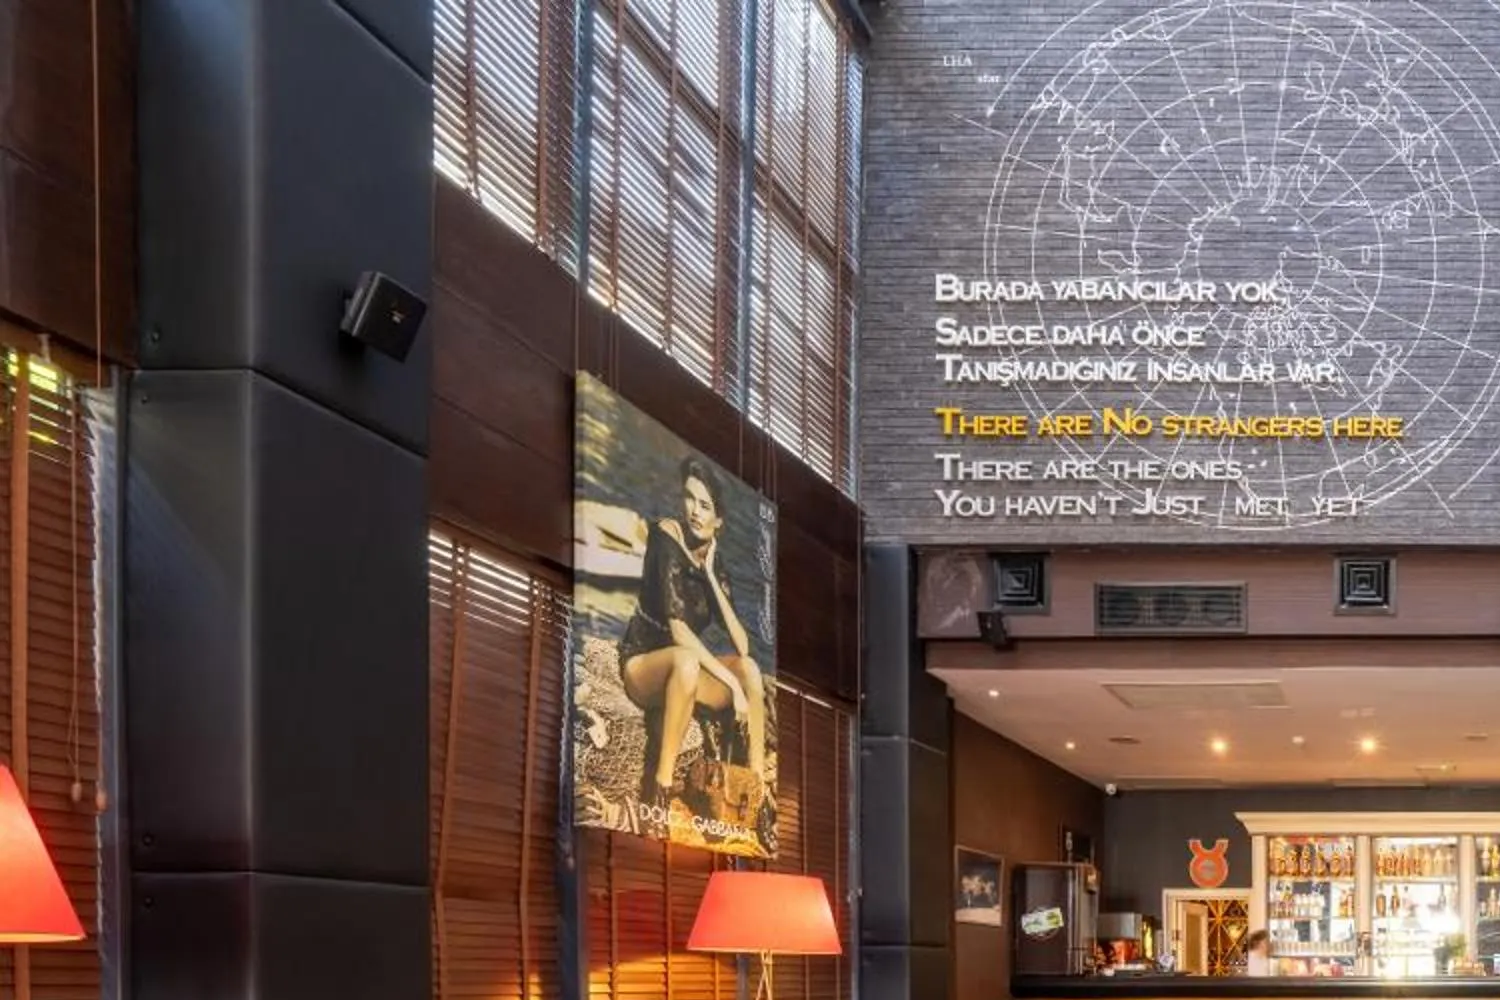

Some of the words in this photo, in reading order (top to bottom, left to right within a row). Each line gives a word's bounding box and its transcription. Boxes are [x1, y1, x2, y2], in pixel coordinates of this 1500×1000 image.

[935, 273, 1045, 302] BURADA
[1051, 280, 1217, 302] YABANCILAR
[935, 317, 1043, 346] SADECE
[1053, 325, 1126, 346] DAHA
[1132, 319, 1207, 347] ÖNCE
[934, 407, 1028, 436] THERE
[1037, 415, 1093, 436] ARE
[1102, 406, 1153, 436] NO
[1161, 415, 1324, 437] STRANGERS
[1333, 415, 1404, 437] HERE
[934, 453, 1033, 481] THERE
[1043, 460, 1100, 480] ARE
[1108, 460, 1162, 480] THE
[934, 489, 995, 516] YOU
[1005, 491, 1123, 516] HAVEN'T
[1131, 487, 1206, 516] JUST
[1235, 497, 1289, 516] MET
